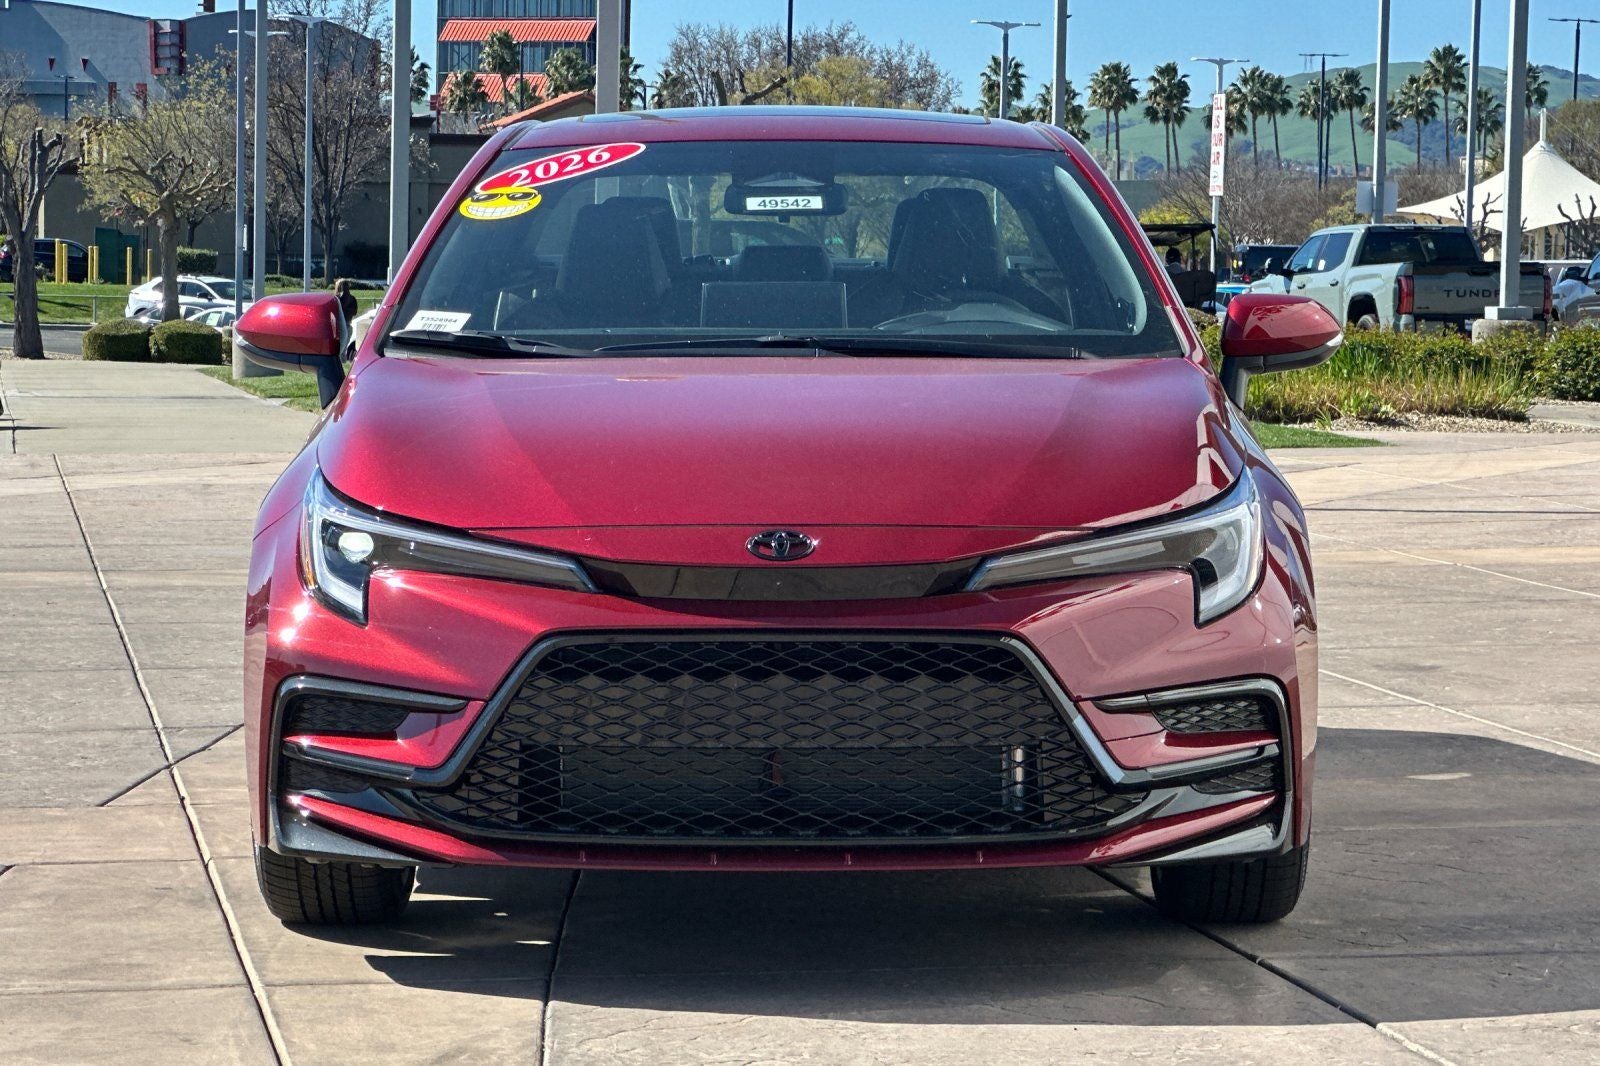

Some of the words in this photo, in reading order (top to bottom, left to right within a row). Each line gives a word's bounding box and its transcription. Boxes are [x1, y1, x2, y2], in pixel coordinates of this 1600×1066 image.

[1214, 96, 1223, 111] ELL
[508, 146, 611, 187] 2026
[757, 198, 812, 209] 49542
[1443, 289, 1500, 298] TUNDR
